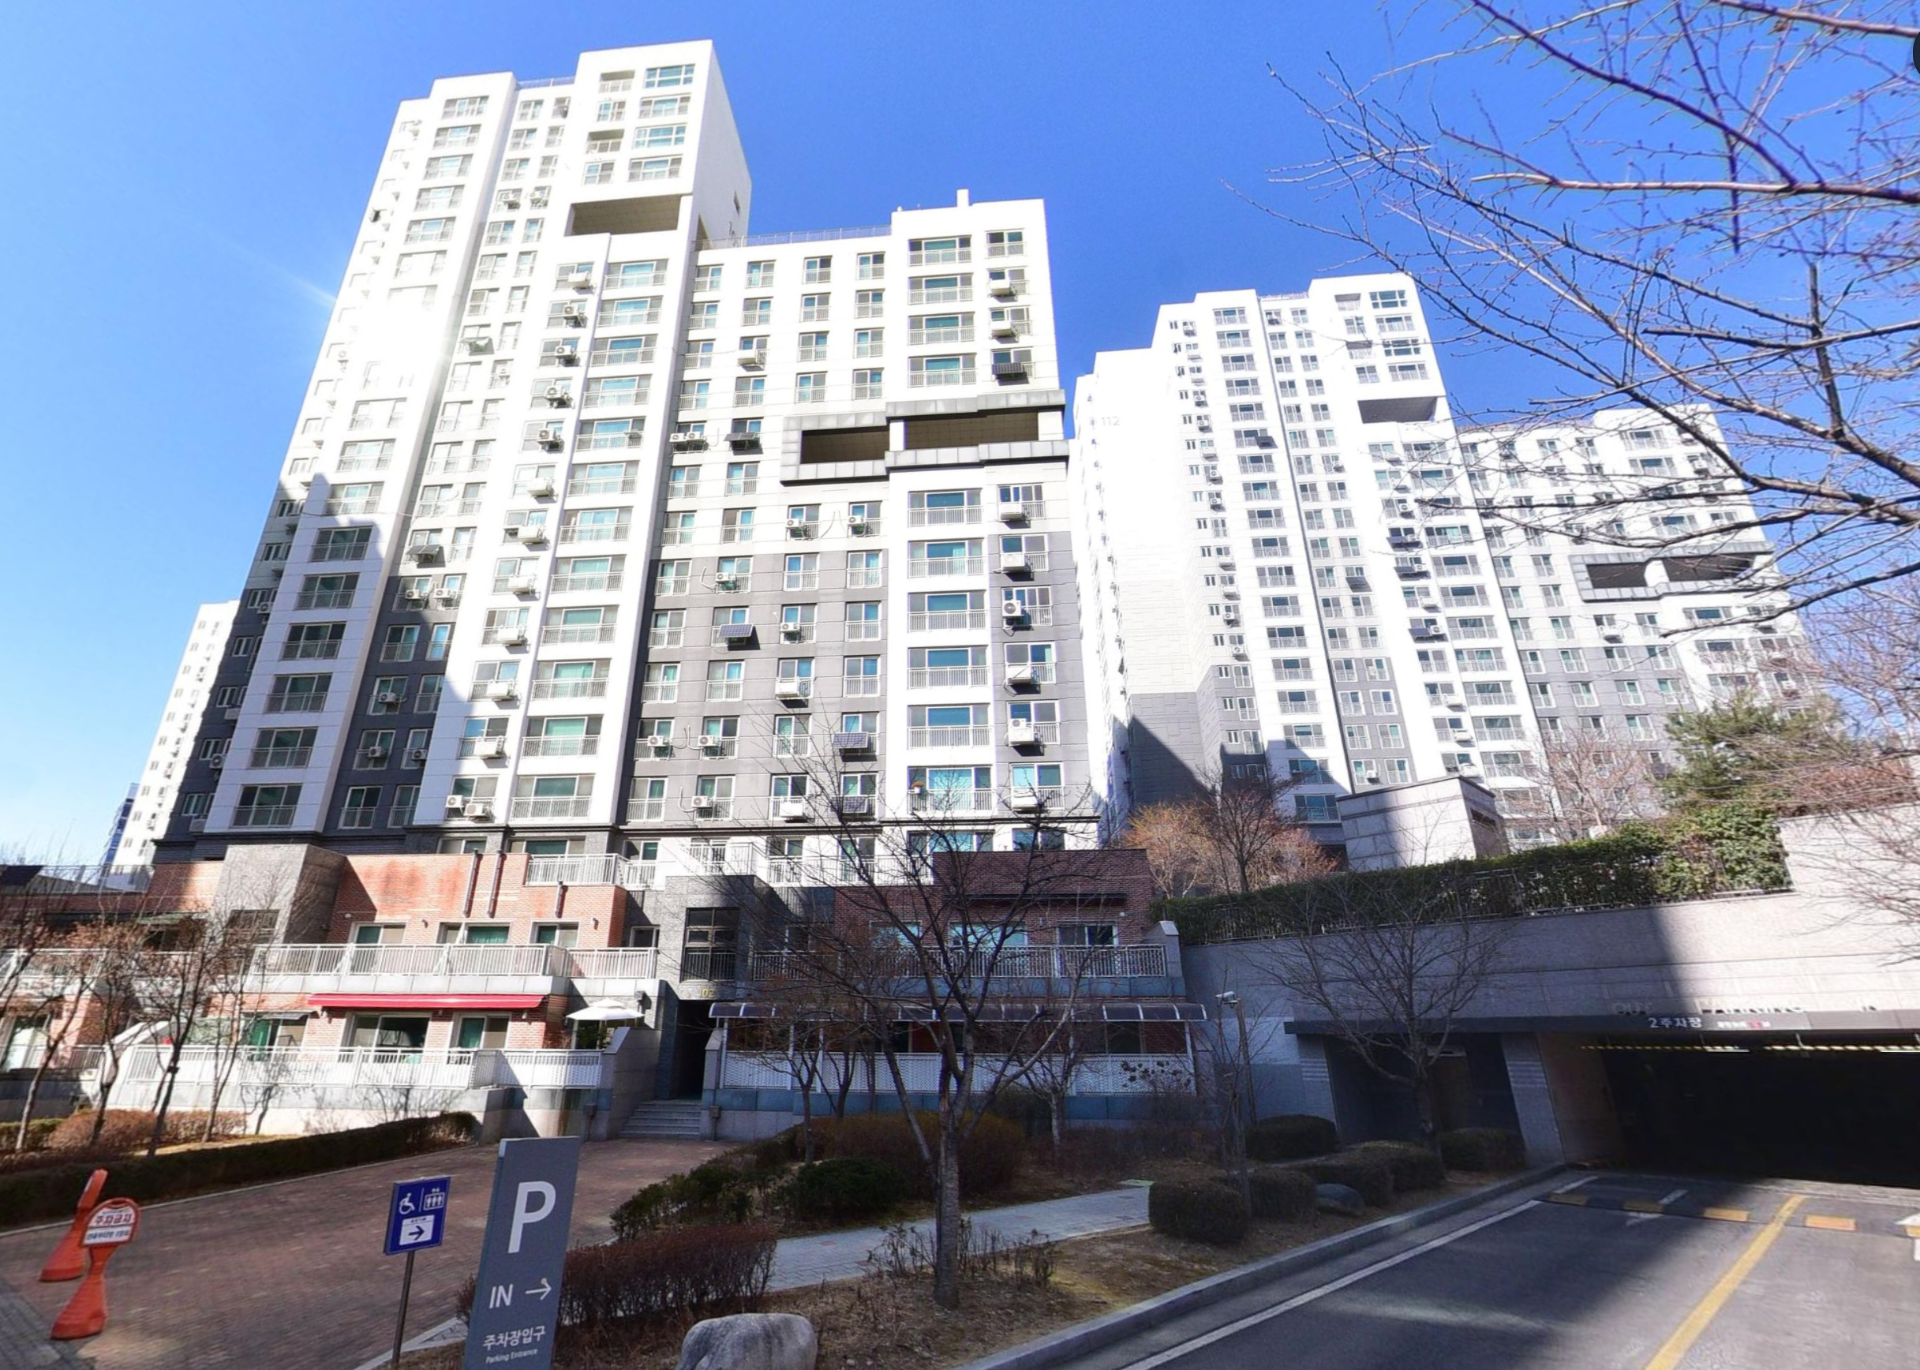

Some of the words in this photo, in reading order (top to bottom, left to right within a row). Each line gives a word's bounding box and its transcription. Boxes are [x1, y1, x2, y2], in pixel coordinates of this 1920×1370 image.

[1101, 416, 1120, 426] 112
[508, 1180, 556, 1254] P
[488, 1283, 514, 1309] IN
[482, 1325, 547, 1351] 주차장입구
